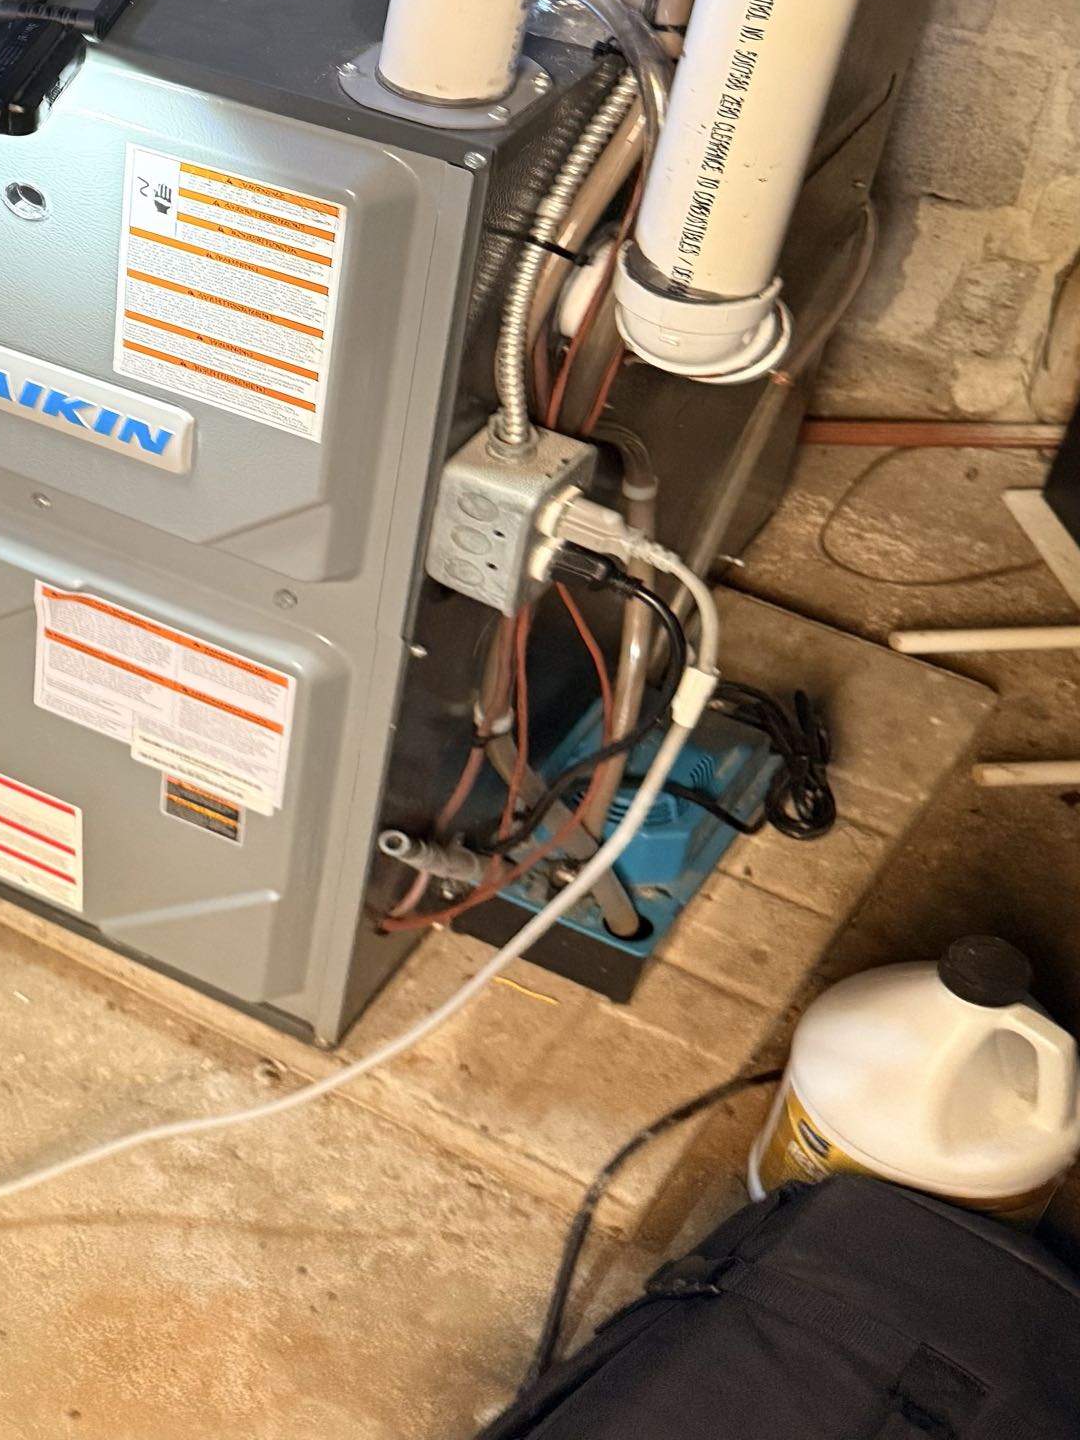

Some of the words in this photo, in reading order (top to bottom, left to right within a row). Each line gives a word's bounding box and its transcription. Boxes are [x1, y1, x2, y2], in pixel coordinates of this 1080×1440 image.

[717, 93, 744, 119] ZERO
[701, 121, 736, 174] CLEARANCE
[697, 176, 720, 189] TO
[678, 190, 715, 256] COMBUSTIBLES
